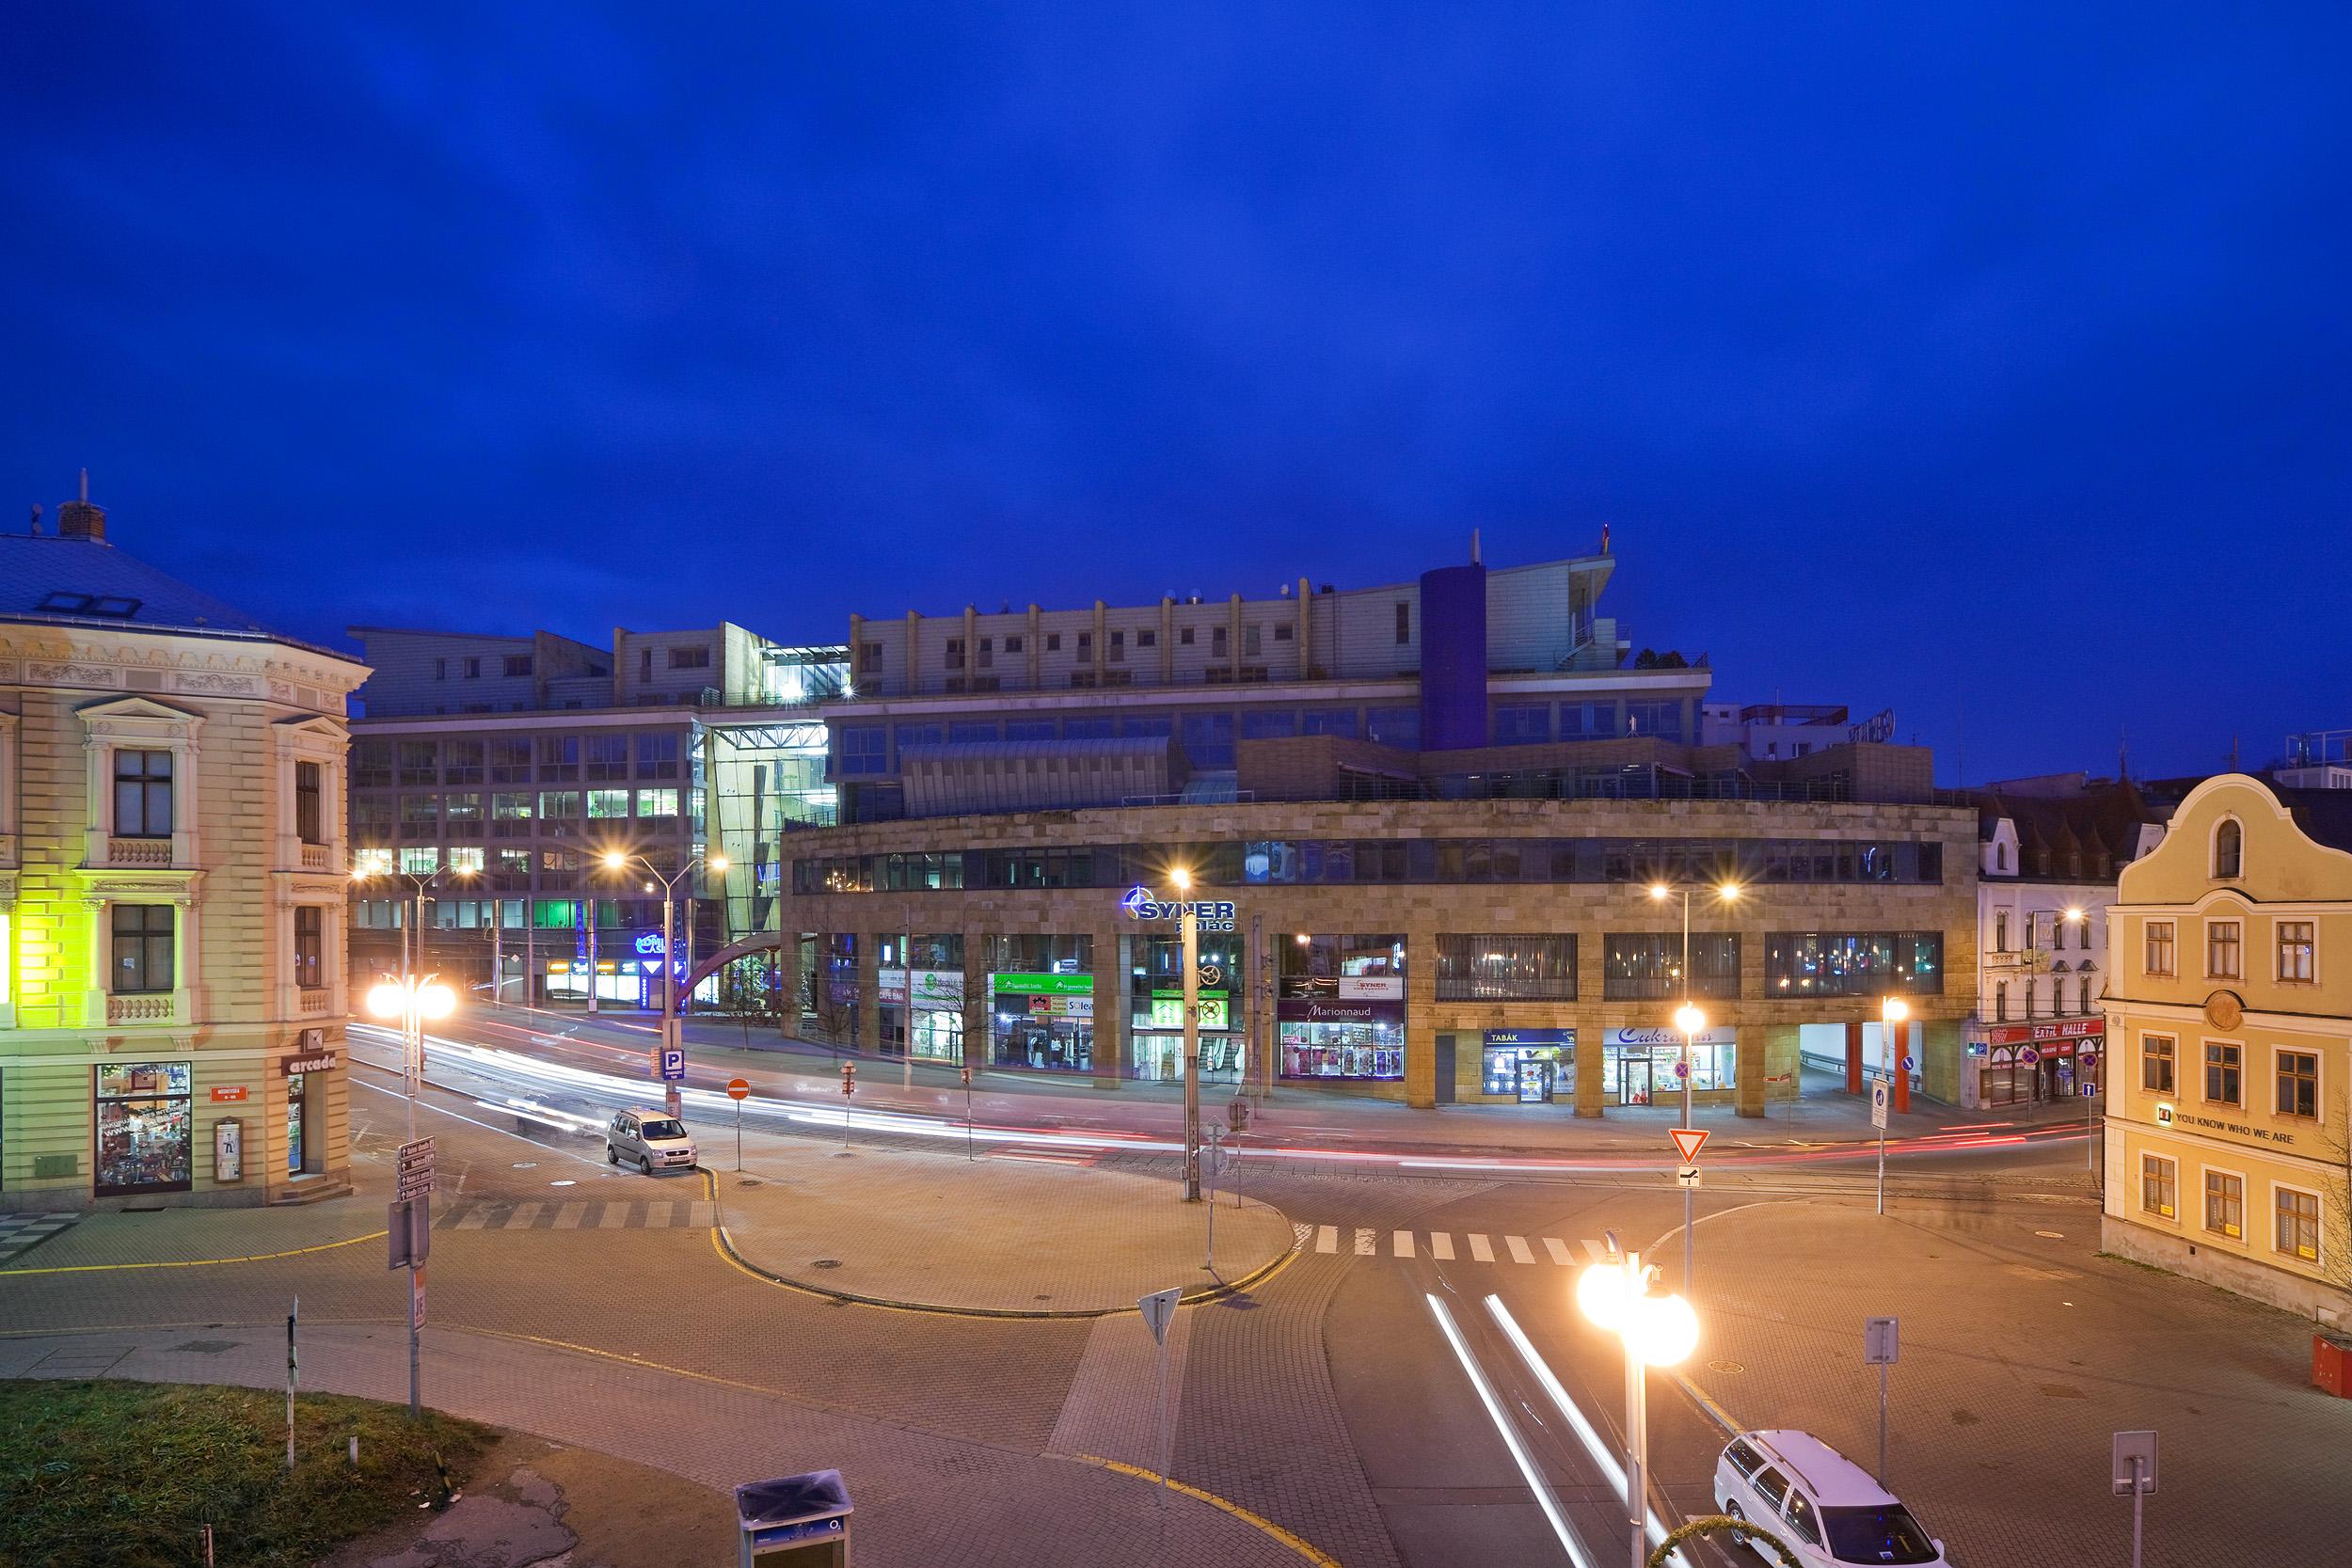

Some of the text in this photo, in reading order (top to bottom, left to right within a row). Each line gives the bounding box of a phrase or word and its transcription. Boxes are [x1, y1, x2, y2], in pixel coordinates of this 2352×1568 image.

[1138, 901, 1235, 920] SYNER
[1175, 920, 1235, 933] plác
[1307, 1004, 1371, 1019] Marionnaud
[1490, 1033, 1518, 1042] TABÁK
[2033, 1022, 2088, 1038] EXTIL HALLE
[289, 1054, 336, 1073] arcada
[668, 1053, 680, 1068] P
[2176, 1113, 2295, 1145] YOU KNOW WHO WE ARE
